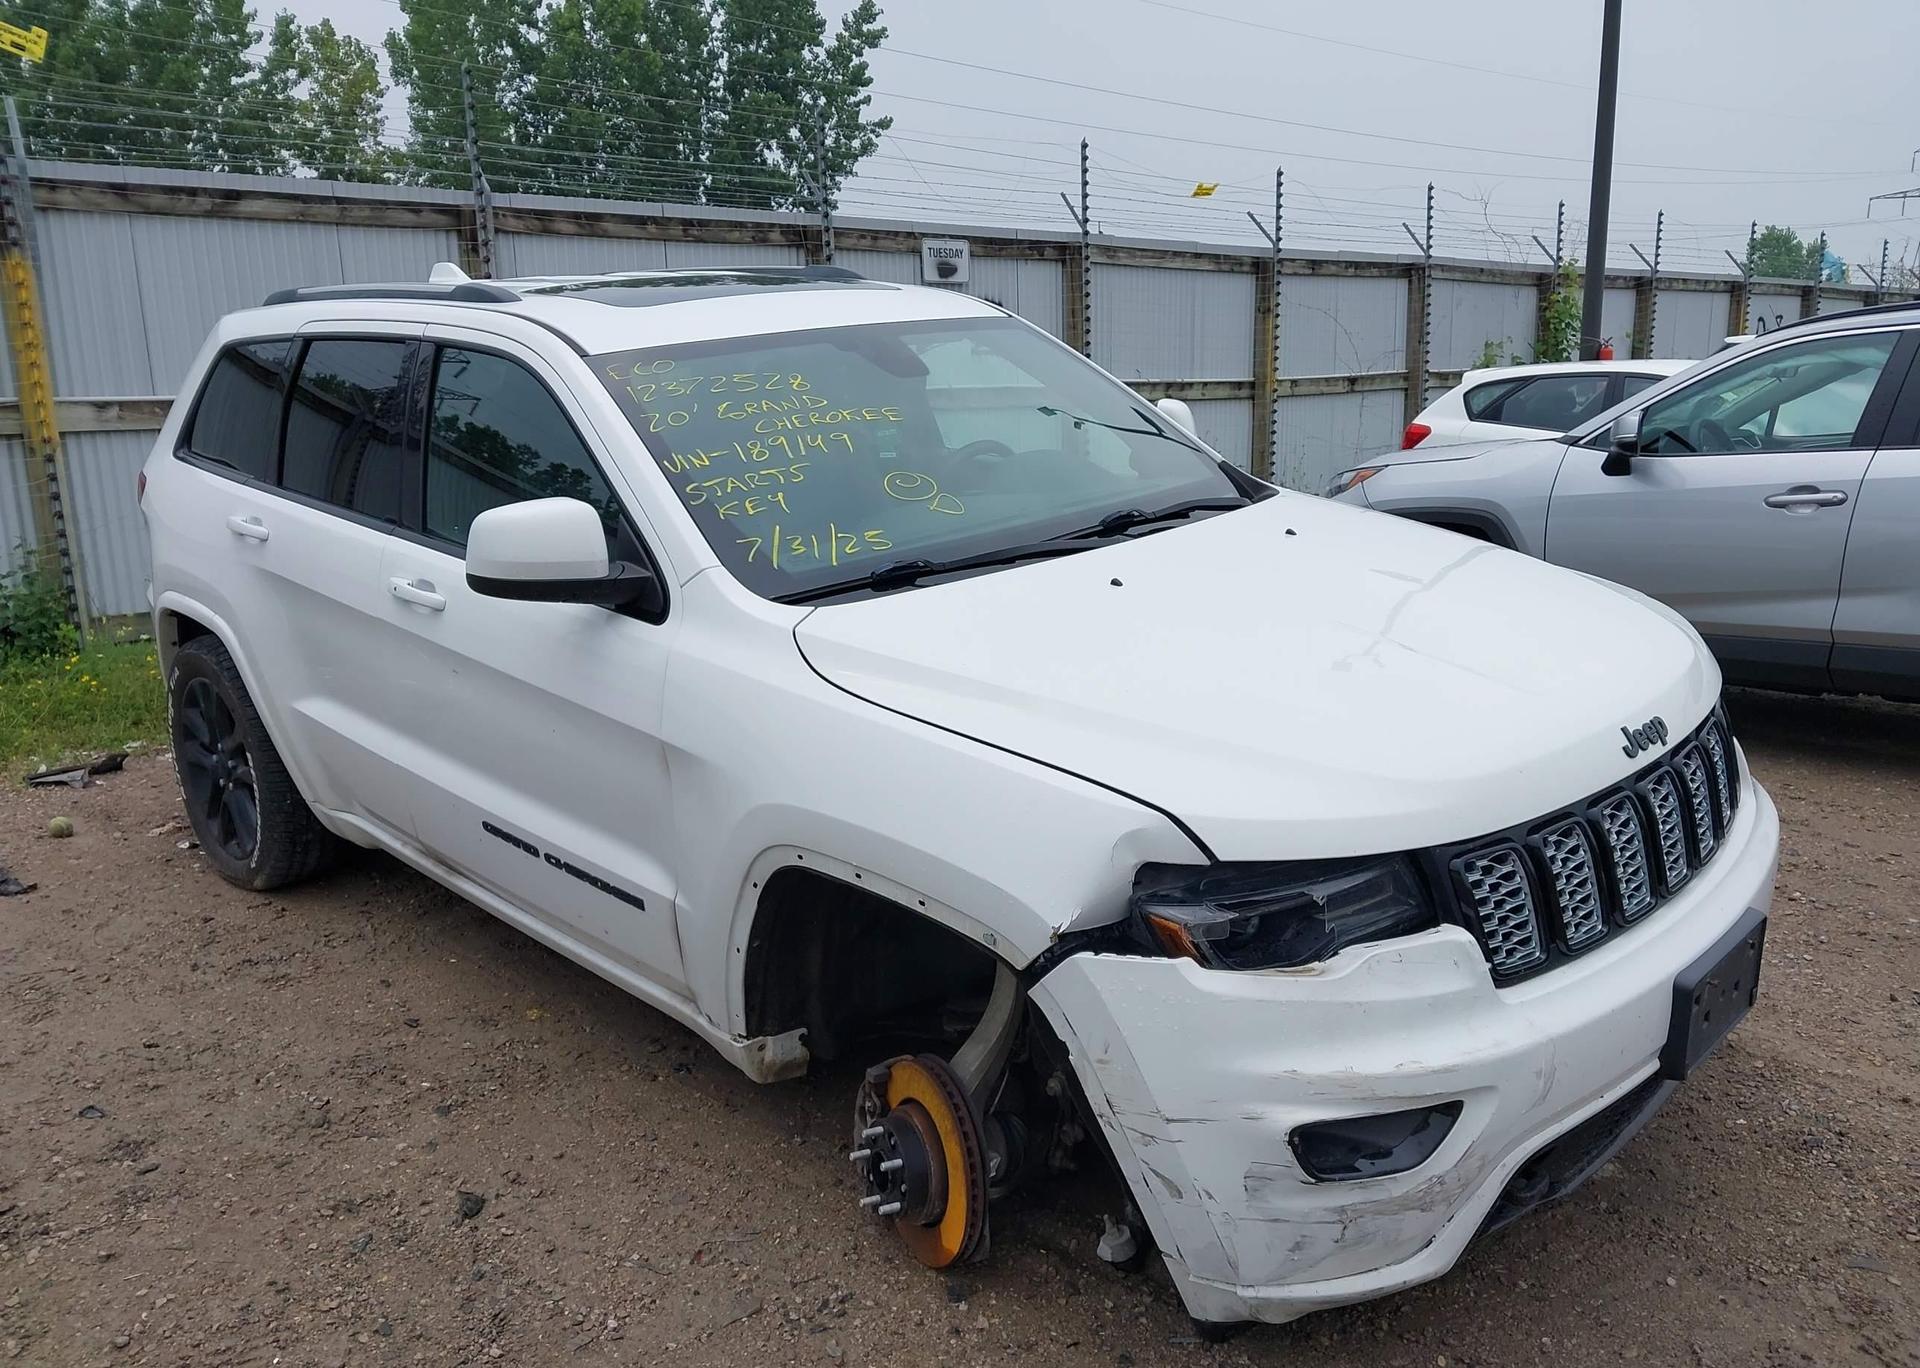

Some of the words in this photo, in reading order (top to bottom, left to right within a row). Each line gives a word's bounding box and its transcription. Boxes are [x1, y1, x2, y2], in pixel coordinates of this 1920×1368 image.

[928, 247, 964, 259] TUESDAY
[606, 359, 676, 380] ECO
[626, 372, 811, 404] 12372528
[717, 395, 828, 420] GRAND
[755, 406, 906, 434] CHEROKEE
[686, 463, 811, 505] STARTS
[714, 492, 791, 520] KEY
[736, 523, 893, 570] 7/31/25
[1620, 715, 1669, 759] Jeep
